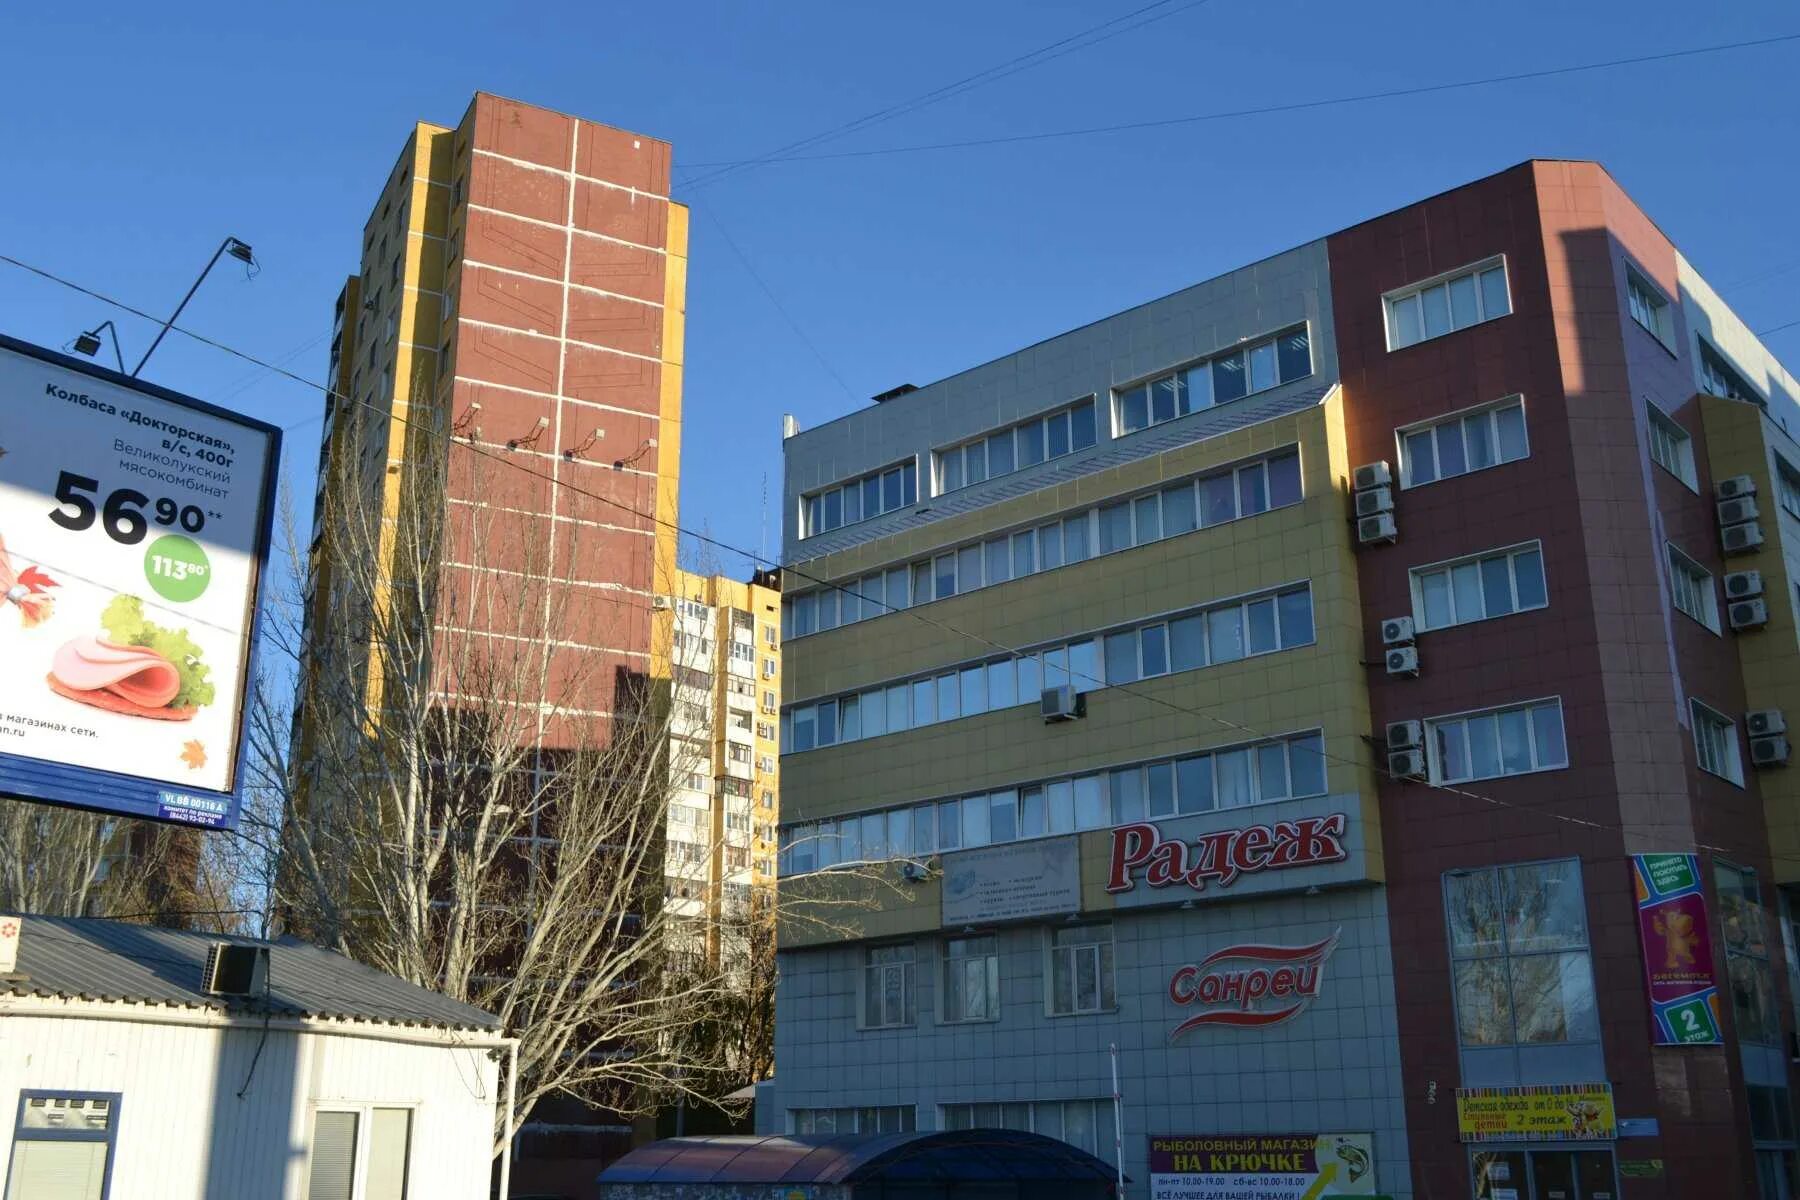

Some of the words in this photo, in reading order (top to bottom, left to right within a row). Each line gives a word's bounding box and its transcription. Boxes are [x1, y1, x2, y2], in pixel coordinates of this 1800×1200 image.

[46, 383, 116, 416] Колбаса
[121, 411, 235, 454] «Докторская»,
[114, 438, 231, 484] Великолукский
[162, 439, 191, 458] в/с,
[195, 448, 234, 468] 400г
[119, 460, 229, 499] мясокомбинат
[6, 714, 67, 732] магазинах
[70, 726, 99, 738] сети.
[1105, 813, 1348, 894] Радеж
[1169, 957, 1325, 1011] Санрей
[1680, 1009, 1700, 1032] 2
[1516, 1114, 1524, 1125] 2
[1528, 1115, 1566, 1126] этаж
[1153, 1137, 1257, 1152] РЫБОЛОВНЫЙ
[1172, 1153, 1203, 1172] НА
[1209, 1152, 1306, 1172] КРЮЧКЕ
[1158, 1177, 1180, 1186] пн-пт
[1233, 1176, 1257, 1186] сб-вс
[1173, 1191, 1205, 1200] ЛУЧШЕЕ
[1206, 1191, 1225, 1200] ДЛЯ
[1225, 1189, 1254, 1200] ВАШЕЙ
